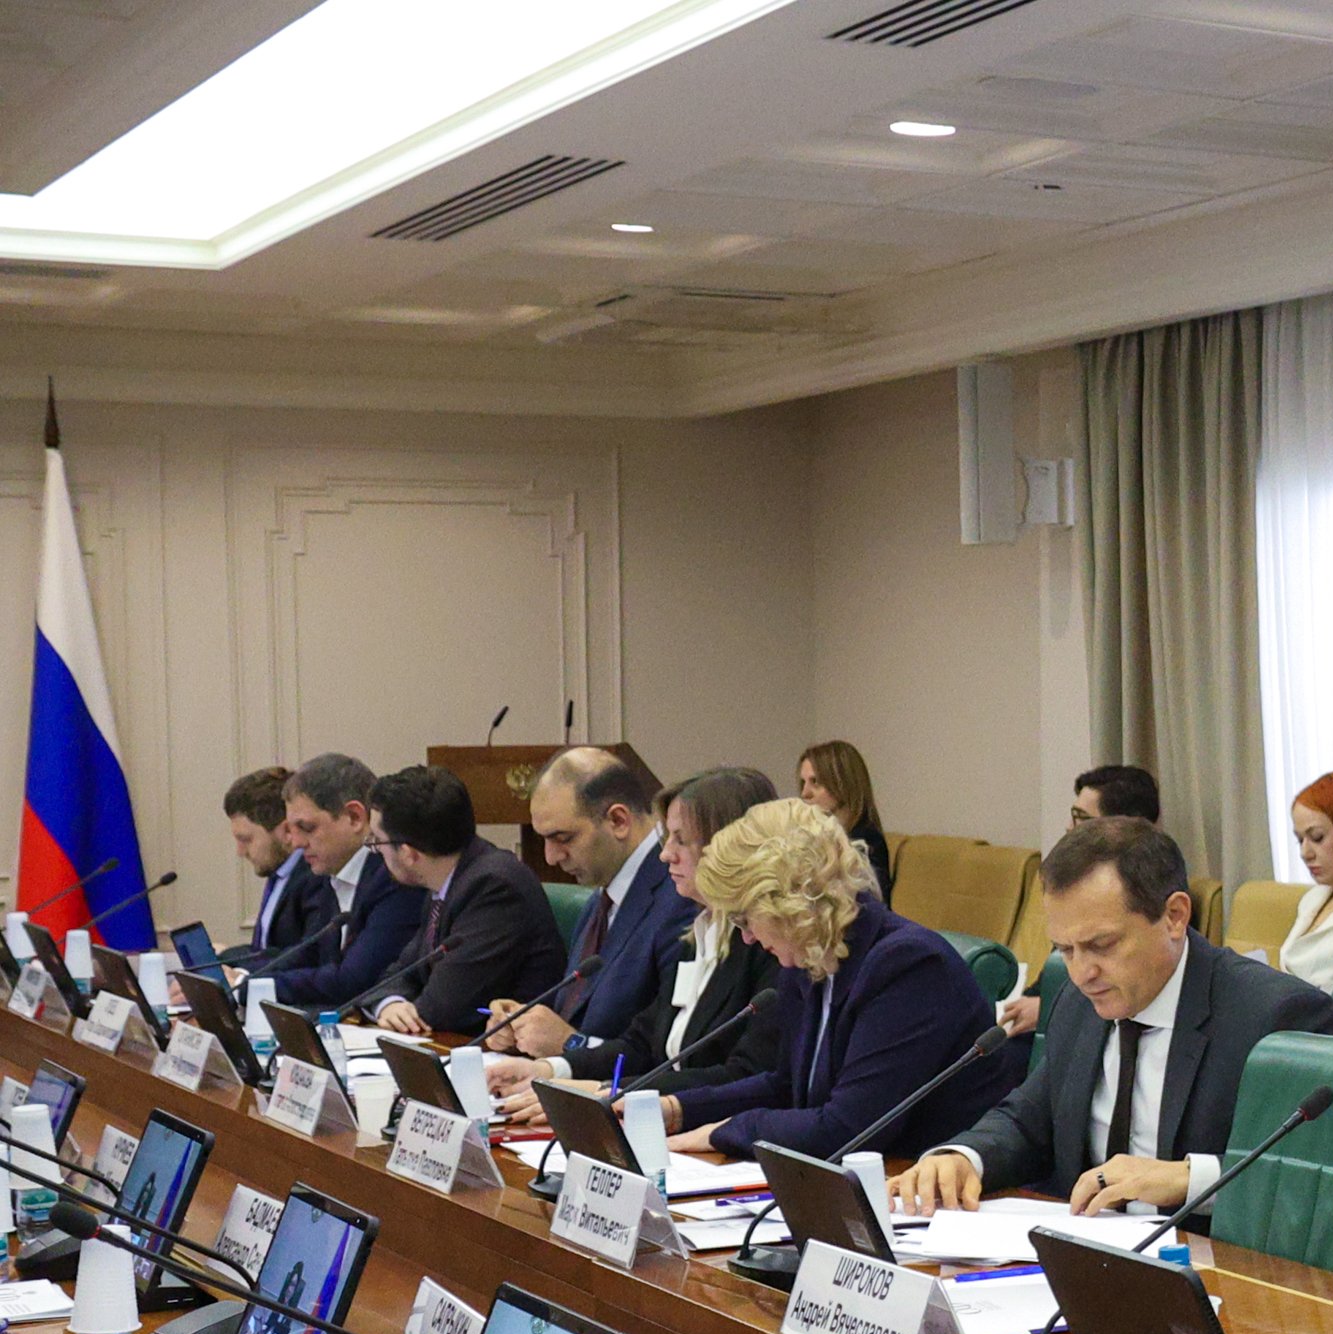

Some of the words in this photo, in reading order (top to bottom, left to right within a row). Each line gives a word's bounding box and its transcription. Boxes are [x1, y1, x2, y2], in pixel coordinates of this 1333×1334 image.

[585, 1165, 623, 1199] ГЕЛЛЕР
[245, 1197, 281, 1235] БАДМАЕ
[578, 1203, 631, 1246] Витальевич
[832, 1256, 895, 1301] ШИРОКОВ
